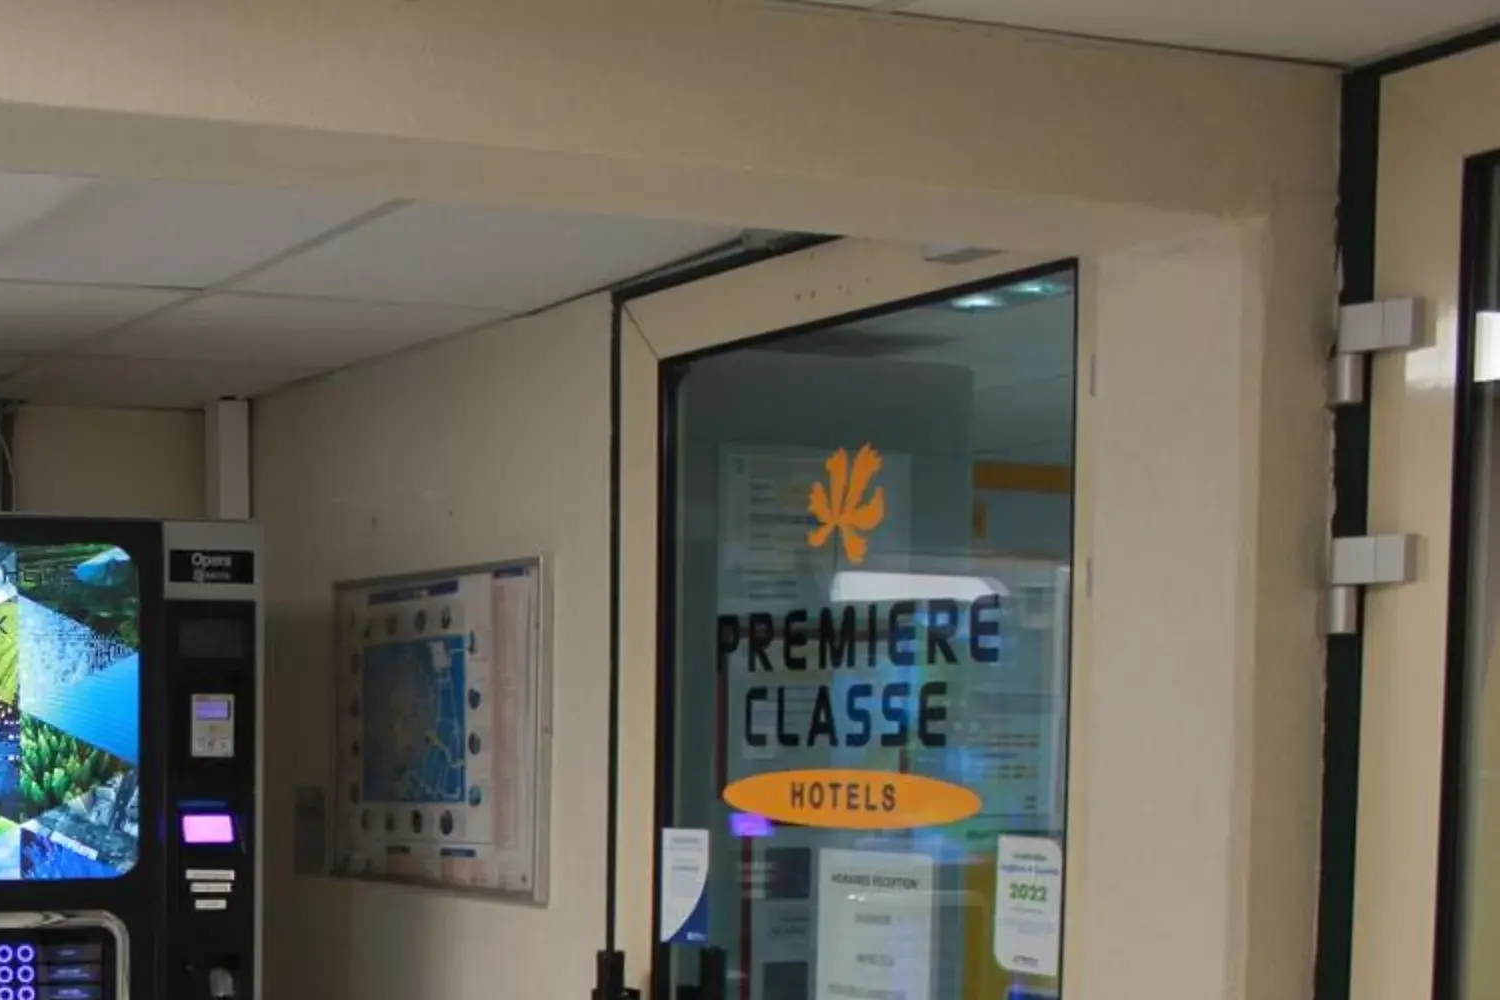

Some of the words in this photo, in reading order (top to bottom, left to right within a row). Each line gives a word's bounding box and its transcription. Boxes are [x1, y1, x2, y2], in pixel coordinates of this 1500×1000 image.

[717, 594, 1001, 673] PREMIERE
[744, 681, 948, 747] CLASSE
[790, 782, 897, 812] HOTELS
[1008, 882, 1048, 902] 2022
